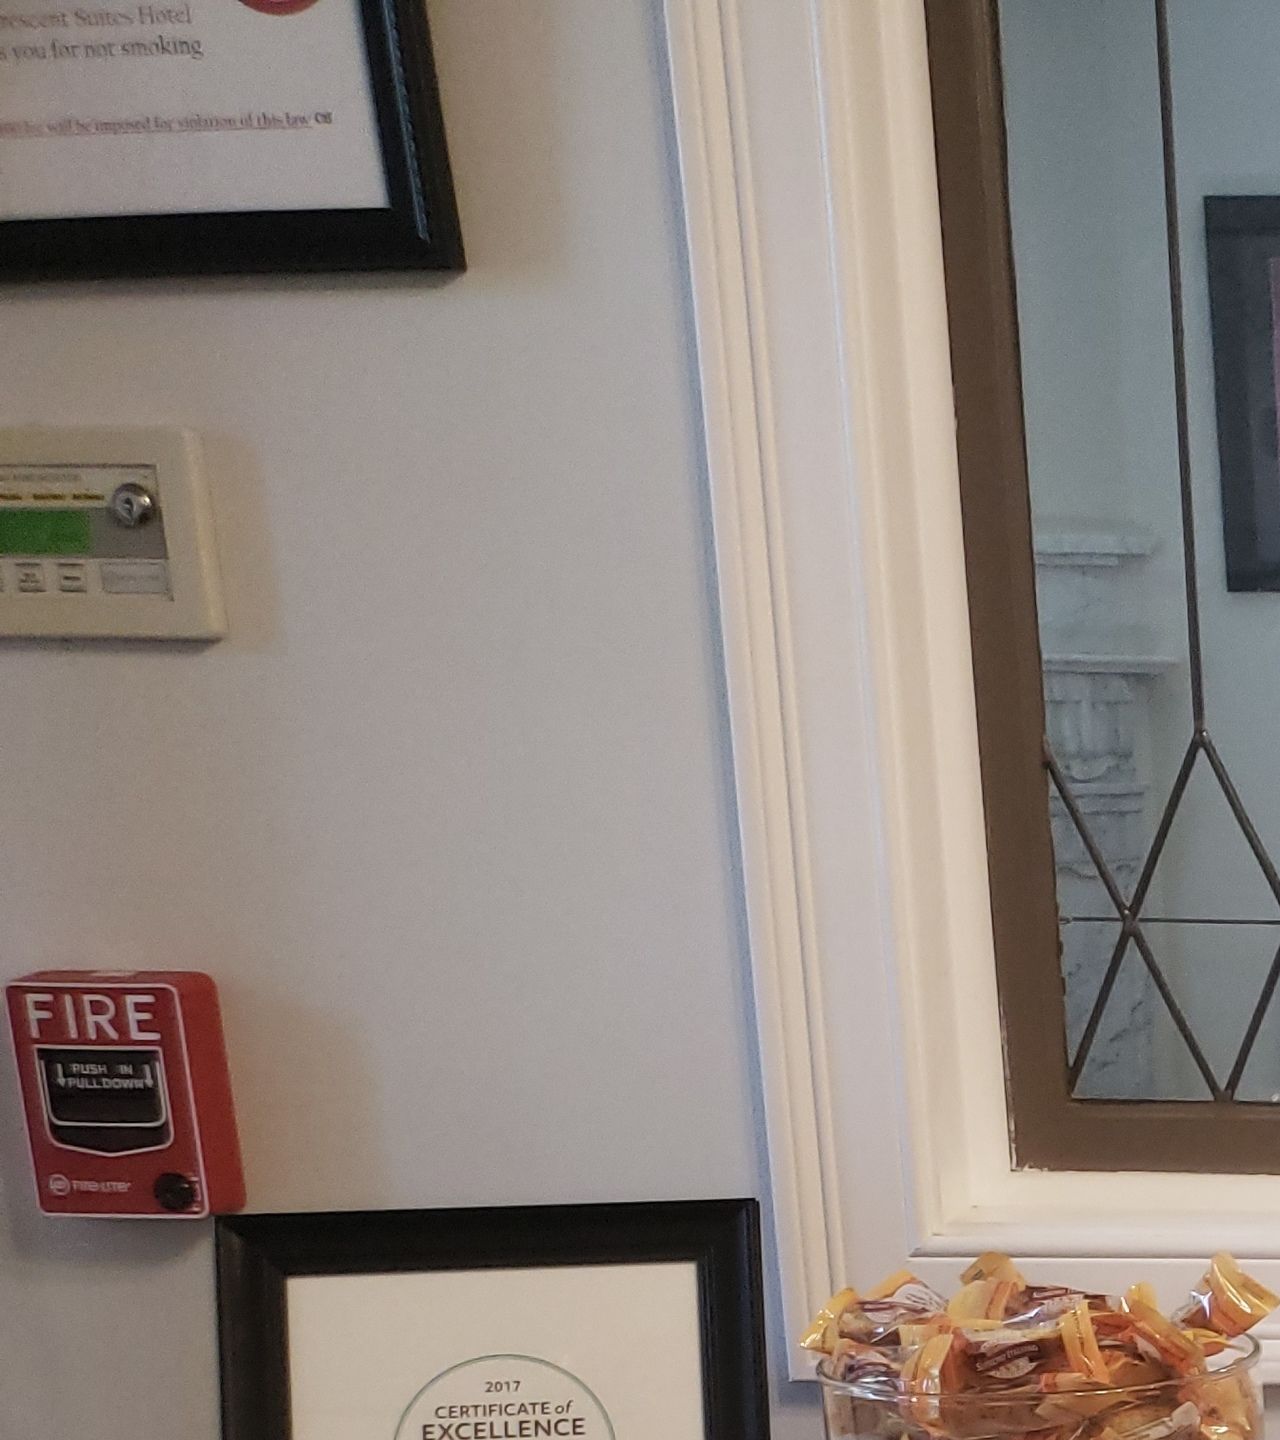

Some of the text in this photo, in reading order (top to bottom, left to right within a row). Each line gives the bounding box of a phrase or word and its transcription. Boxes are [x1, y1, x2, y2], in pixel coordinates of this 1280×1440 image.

[138, 4, 193, 25] Hotel
[120, 35, 204, 60] smoking
[25, 992, 161, 1041] FIRE
[72, 1063, 134, 1075] PUSH IN
[484, 1380, 521, 1394] 2017
[434, 1399, 574, 1420] CERTIFICATE of
